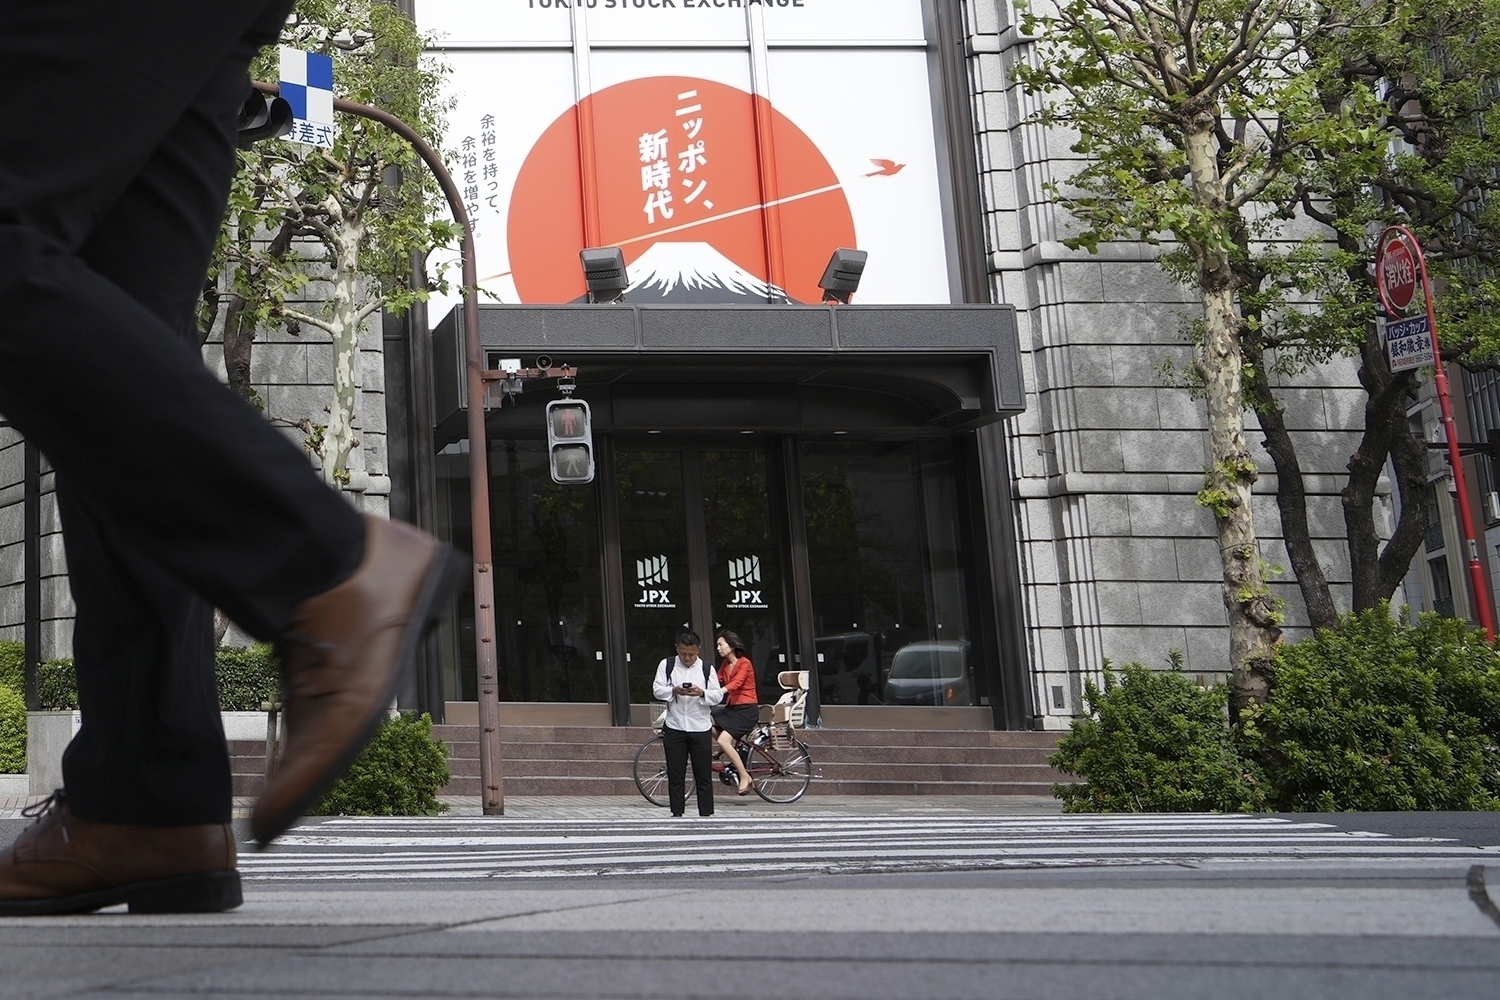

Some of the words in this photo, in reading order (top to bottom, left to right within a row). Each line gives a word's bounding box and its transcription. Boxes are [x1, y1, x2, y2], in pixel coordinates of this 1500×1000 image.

[480, 113, 500, 214] 余裕を持って、
[675, 89, 714, 210] ニッポン、
[638, 128, 674, 224] 新時代
[1385, 257, 1414, 290] 消火栓
[1388, 317, 1427, 339] バッジ・カップ
[639, 590, 670, 603] JPX
[731, 590, 762, 604] JPX
